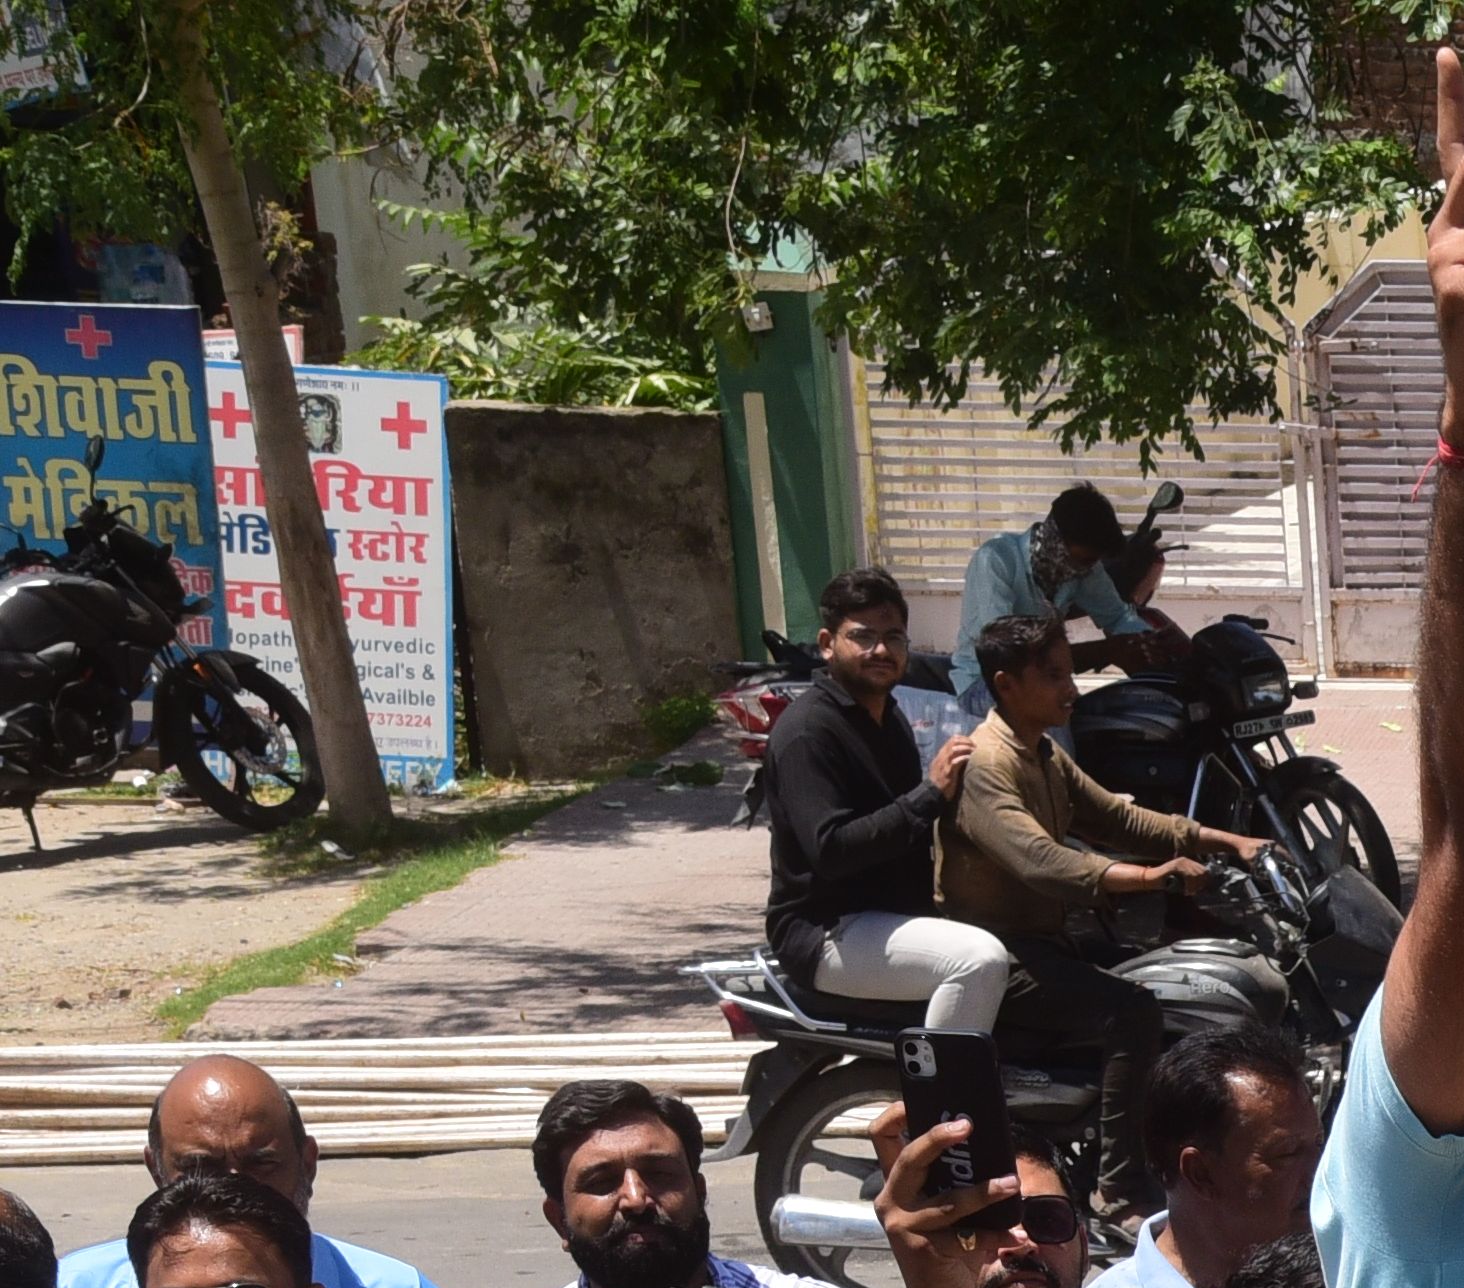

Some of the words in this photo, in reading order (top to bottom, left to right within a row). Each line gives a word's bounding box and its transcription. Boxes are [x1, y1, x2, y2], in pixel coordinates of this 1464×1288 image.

[347, 521, 430, 565] स्टोर
[352, 637, 436, 655] yurvedic
[422, 664, 435, 680] &
[362, 688, 436, 707] Availble
[367, 713, 433, 728] 7373224
[1190, 981, 1230, 995] Hero
